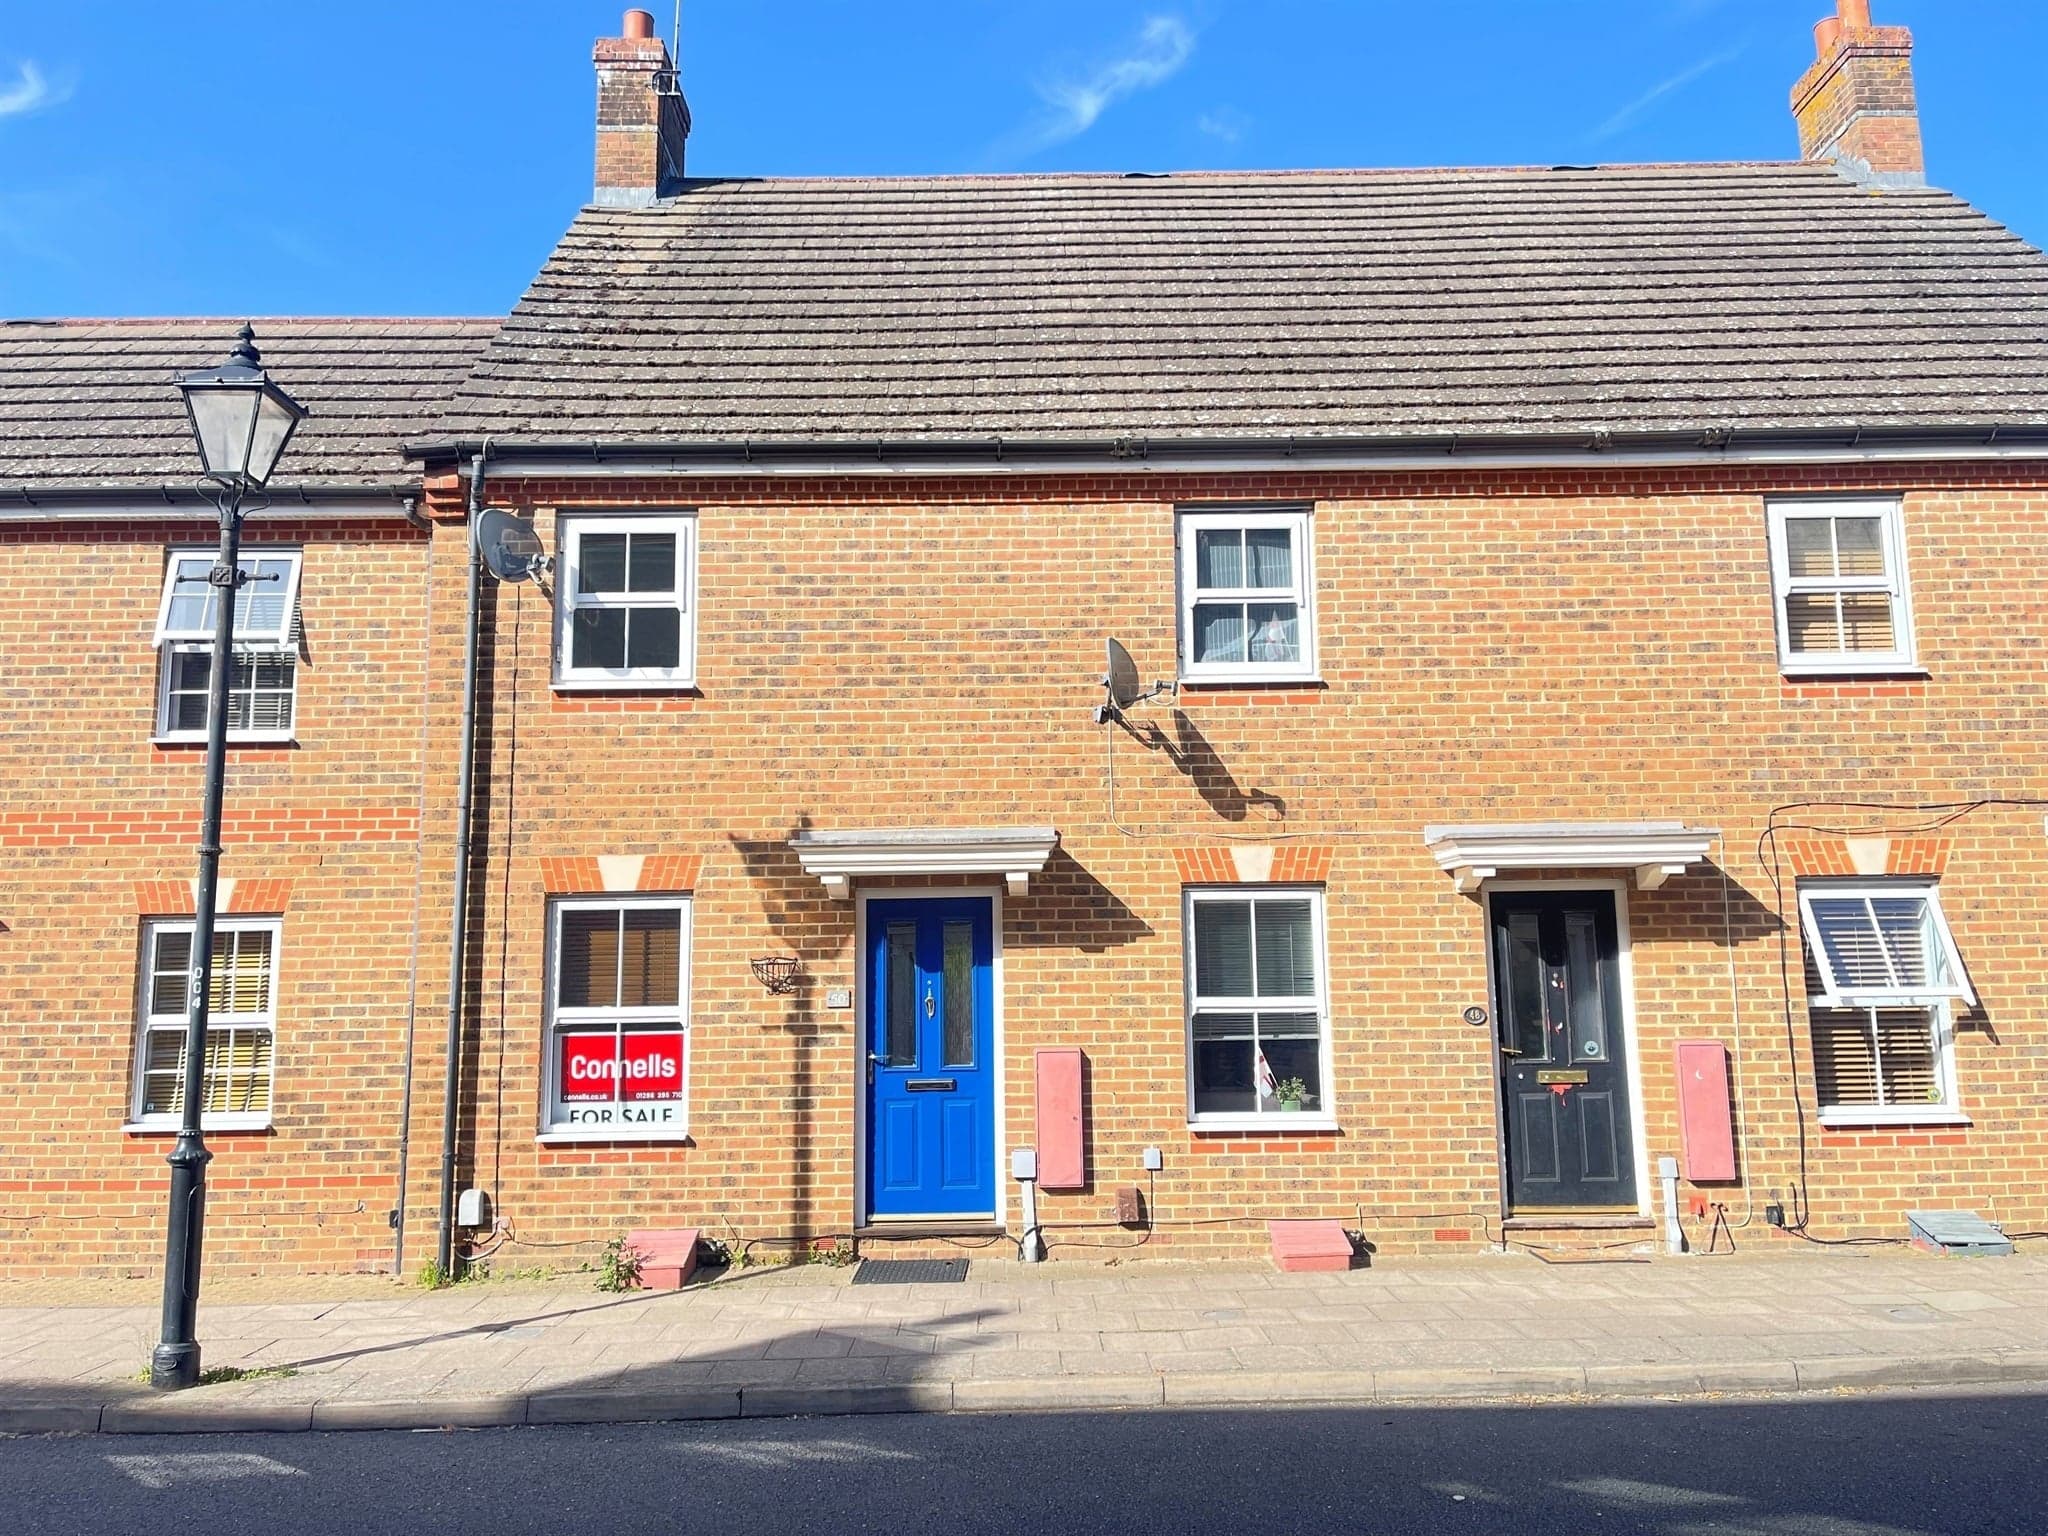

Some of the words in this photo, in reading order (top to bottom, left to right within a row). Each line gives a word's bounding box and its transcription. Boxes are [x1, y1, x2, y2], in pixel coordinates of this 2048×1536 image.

[1470, 1009, 1481, 1020] 48
[570, 1053, 676, 1080] Connells
[570, 1109, 612, 1124] FOR
